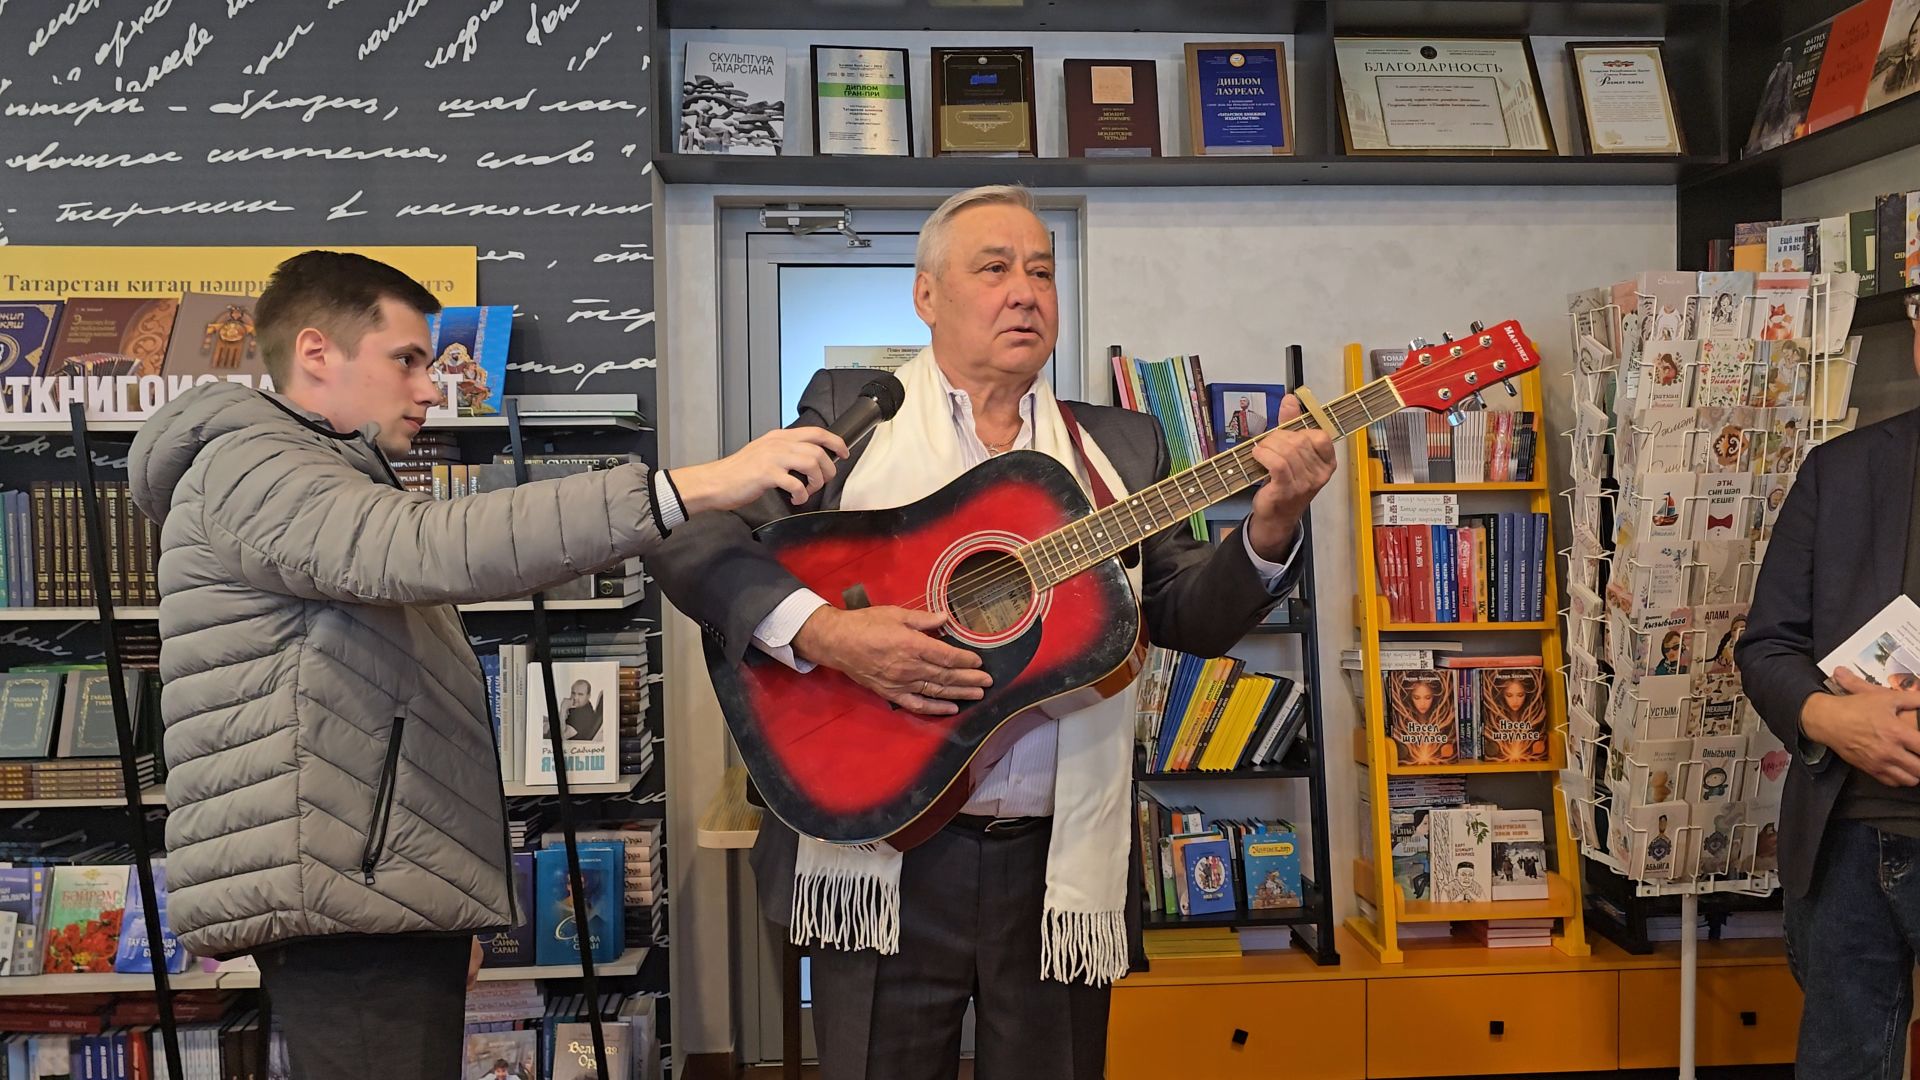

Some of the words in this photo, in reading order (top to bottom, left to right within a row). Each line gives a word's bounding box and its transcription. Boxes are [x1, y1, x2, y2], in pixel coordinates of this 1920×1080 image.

[709, 52, 774, 66] СКУЛЬПТУРА
[712, 62, 773, 75] ТАТАРСТАНА
[1364, 62, 1503, 73] БЛАГОДАРНОСТЬ
[1216, 77, 1261, 88] ДИПЛОМ
[1215, 86, 1264, 96] ЛАУРЕАТА
[4, 275, 119, 296] Татарстан
[128, 280, 191, 293] китап
[1704, 610, 1730, 620] АПАМА
[1408, 722, 1439, 733] Нәсел
[1500, 719, 1532, 730] Нәсел
[568, 1041, 618, 1055] Велиая
